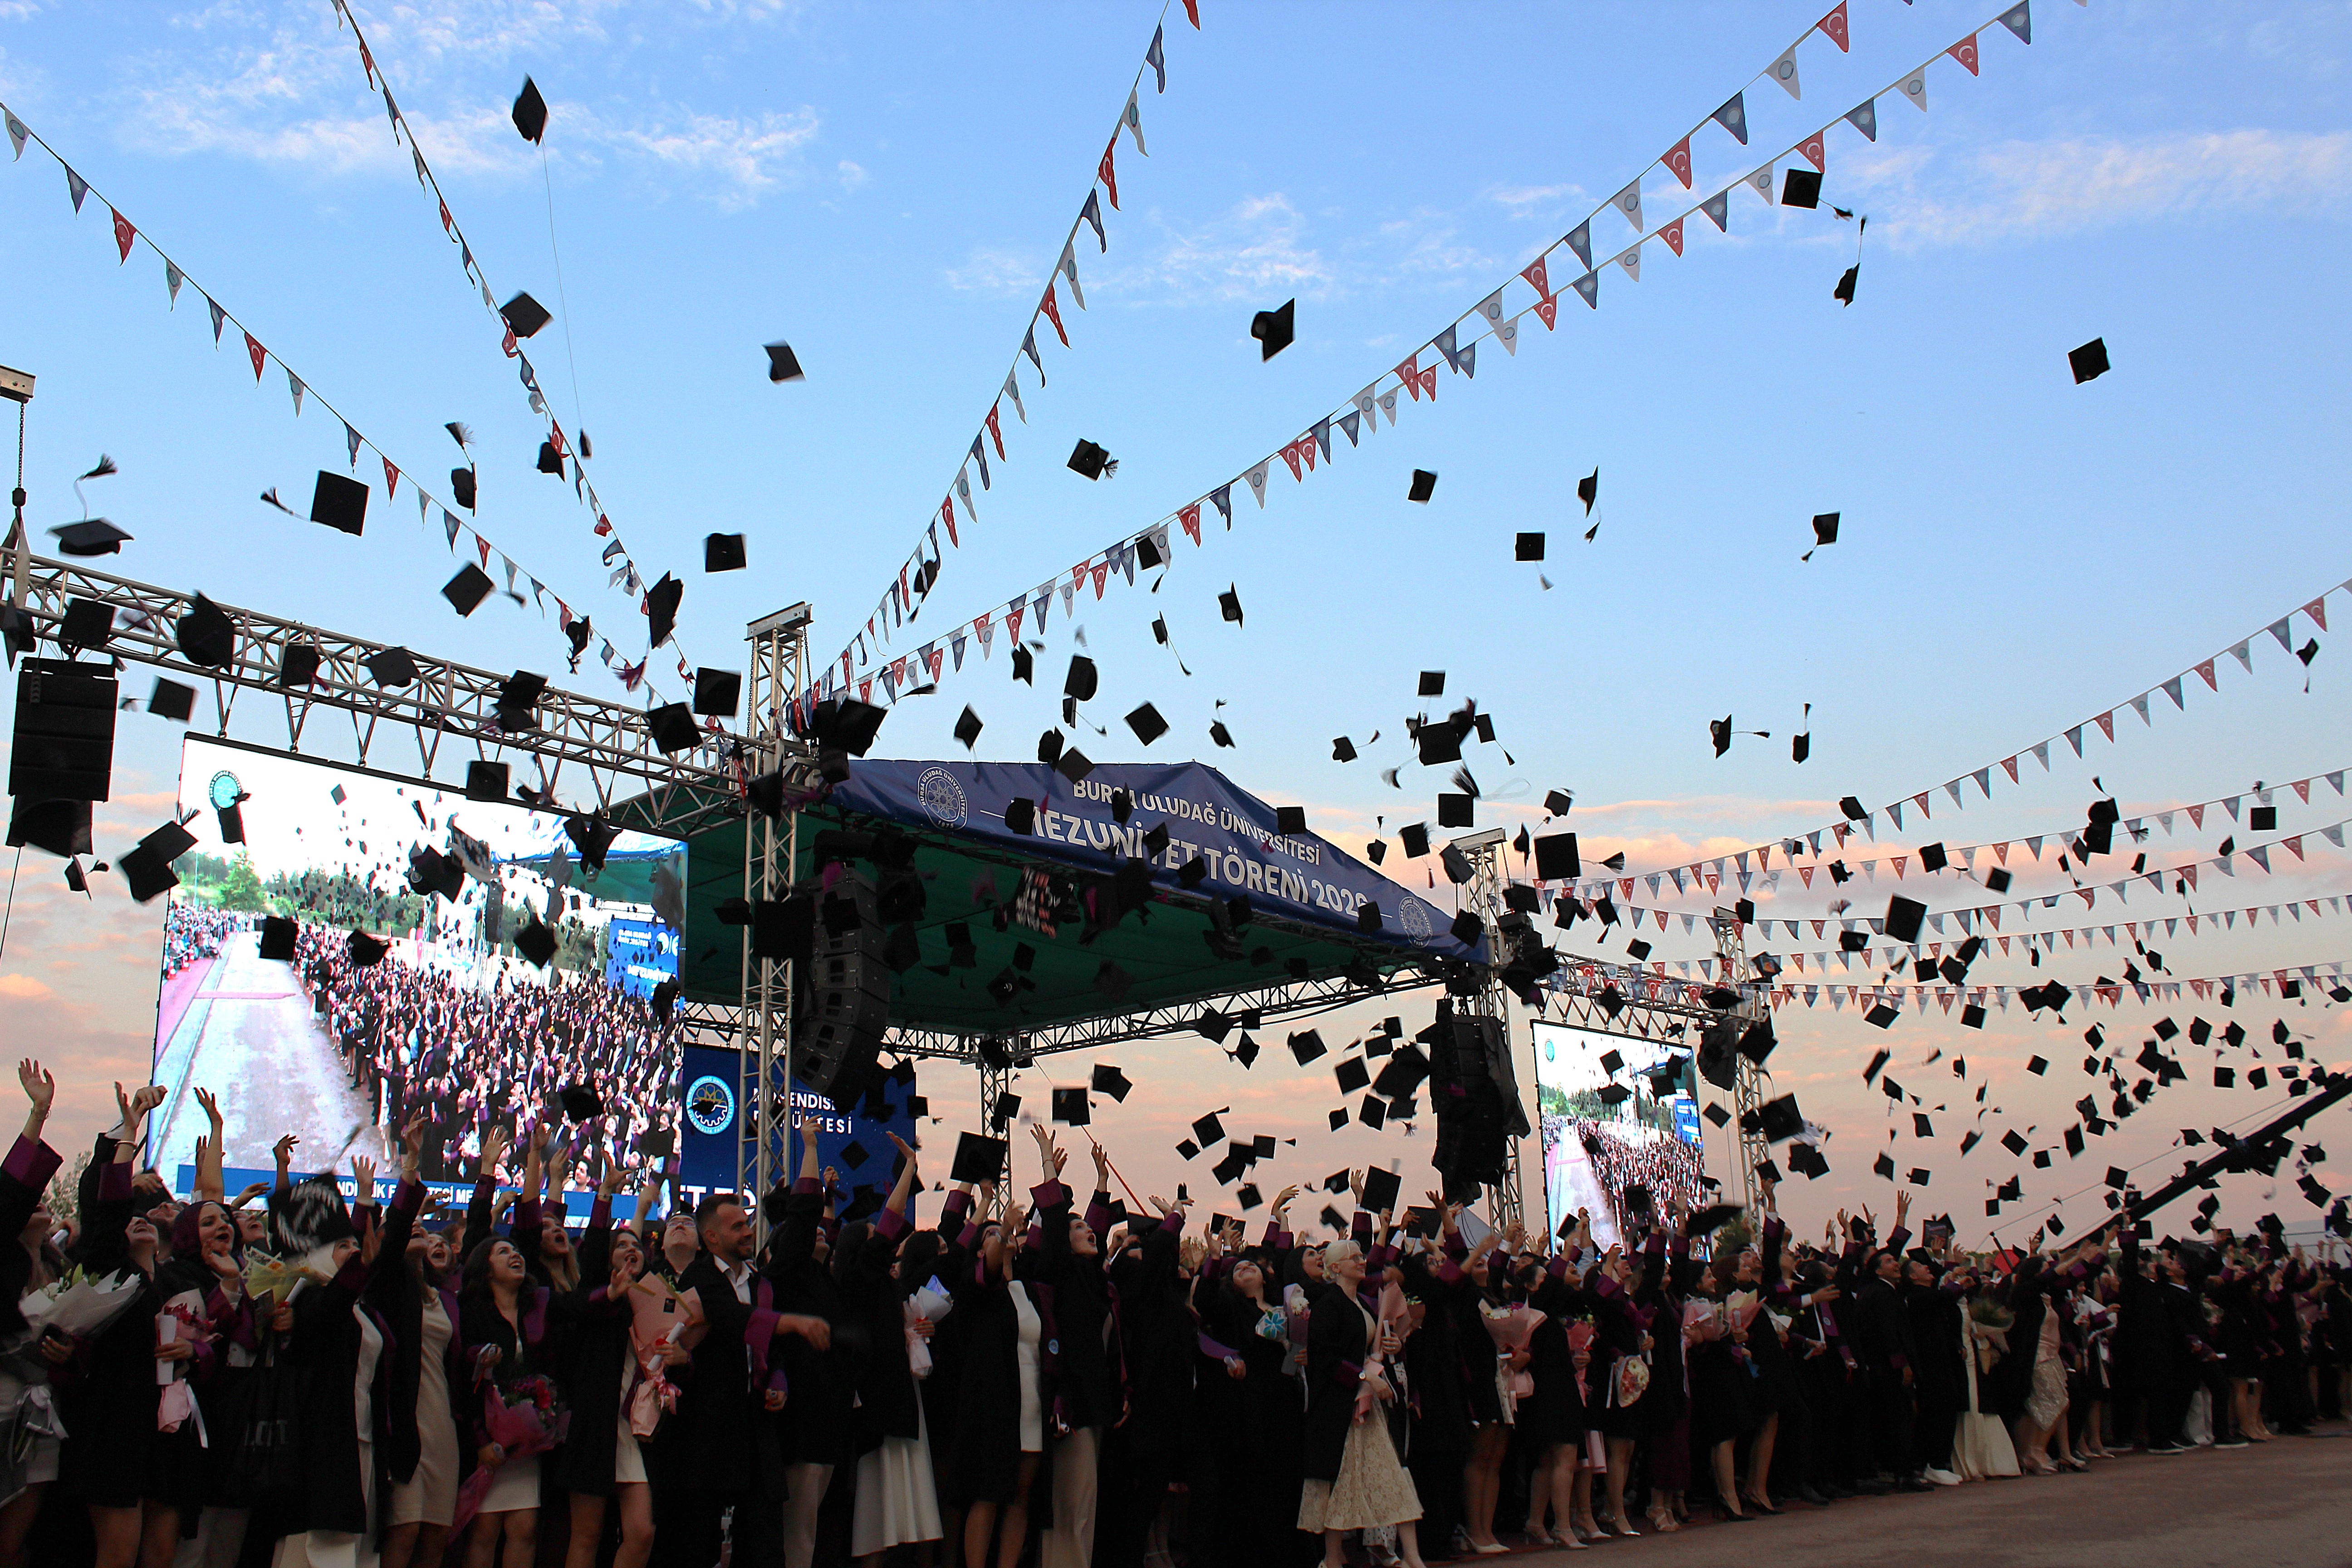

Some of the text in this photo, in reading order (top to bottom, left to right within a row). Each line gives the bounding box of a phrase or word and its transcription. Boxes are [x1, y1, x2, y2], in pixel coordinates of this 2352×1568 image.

[1010, 800, 1198, 870] EZUNİET
[1204, 845, 1310, 904] TÖRENİ
[1142, 793, 1216, 826] ULUDAĞ
[1220, 807, 1320, 866] ÜNİVERSİTESİ
